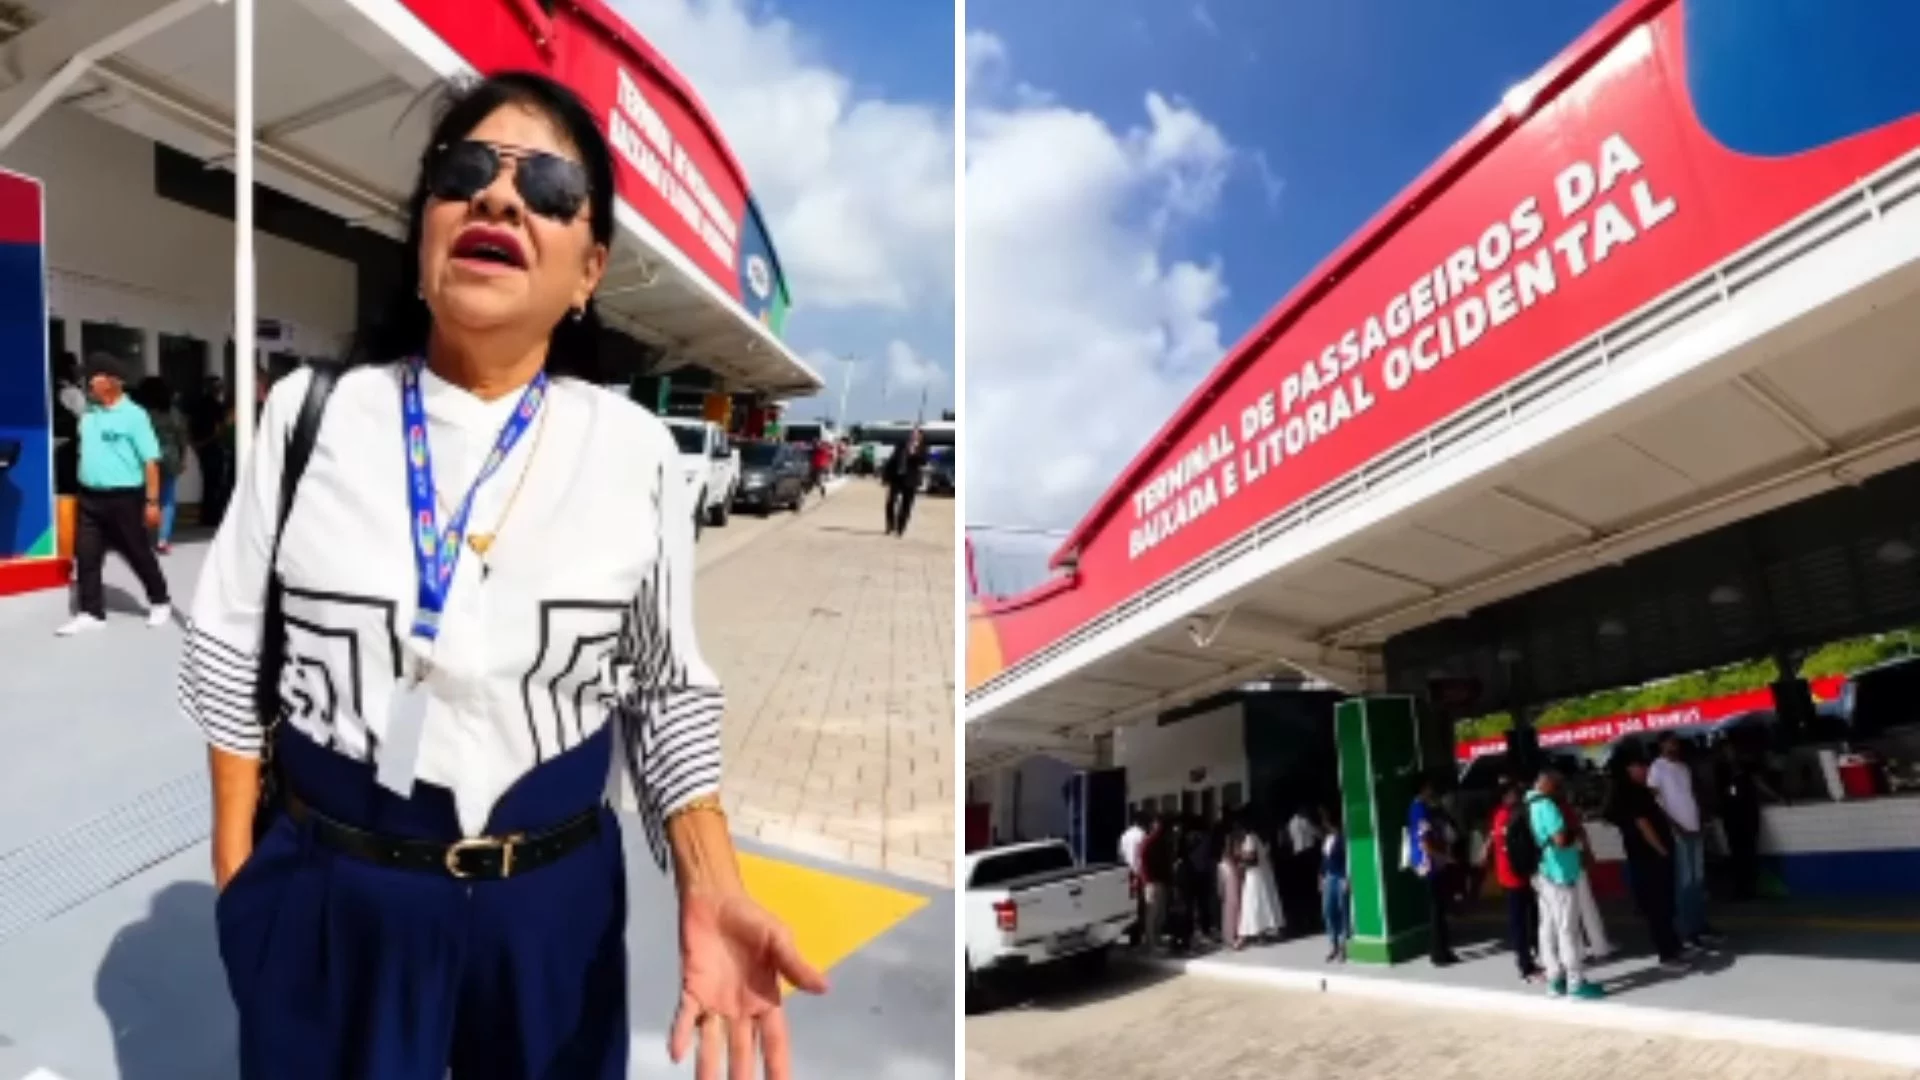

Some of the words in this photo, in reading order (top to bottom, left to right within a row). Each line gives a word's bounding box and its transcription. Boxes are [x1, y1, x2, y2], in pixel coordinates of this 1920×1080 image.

[1128, 477, 1220, 560] BAIXADA
[1221, 460, 1239, 498] E
[1243, 375, 1376, 484] LITORAL
[1382, 179, 1677, 391] OCIDENTAL
[1133, 425, 1235, 518] TERMINAL
[1241, 391, 1276, 442] DE
[1281, 195, 1544, 413] PASSAGEIROS
[1553, 131, 1642, 218] DA
